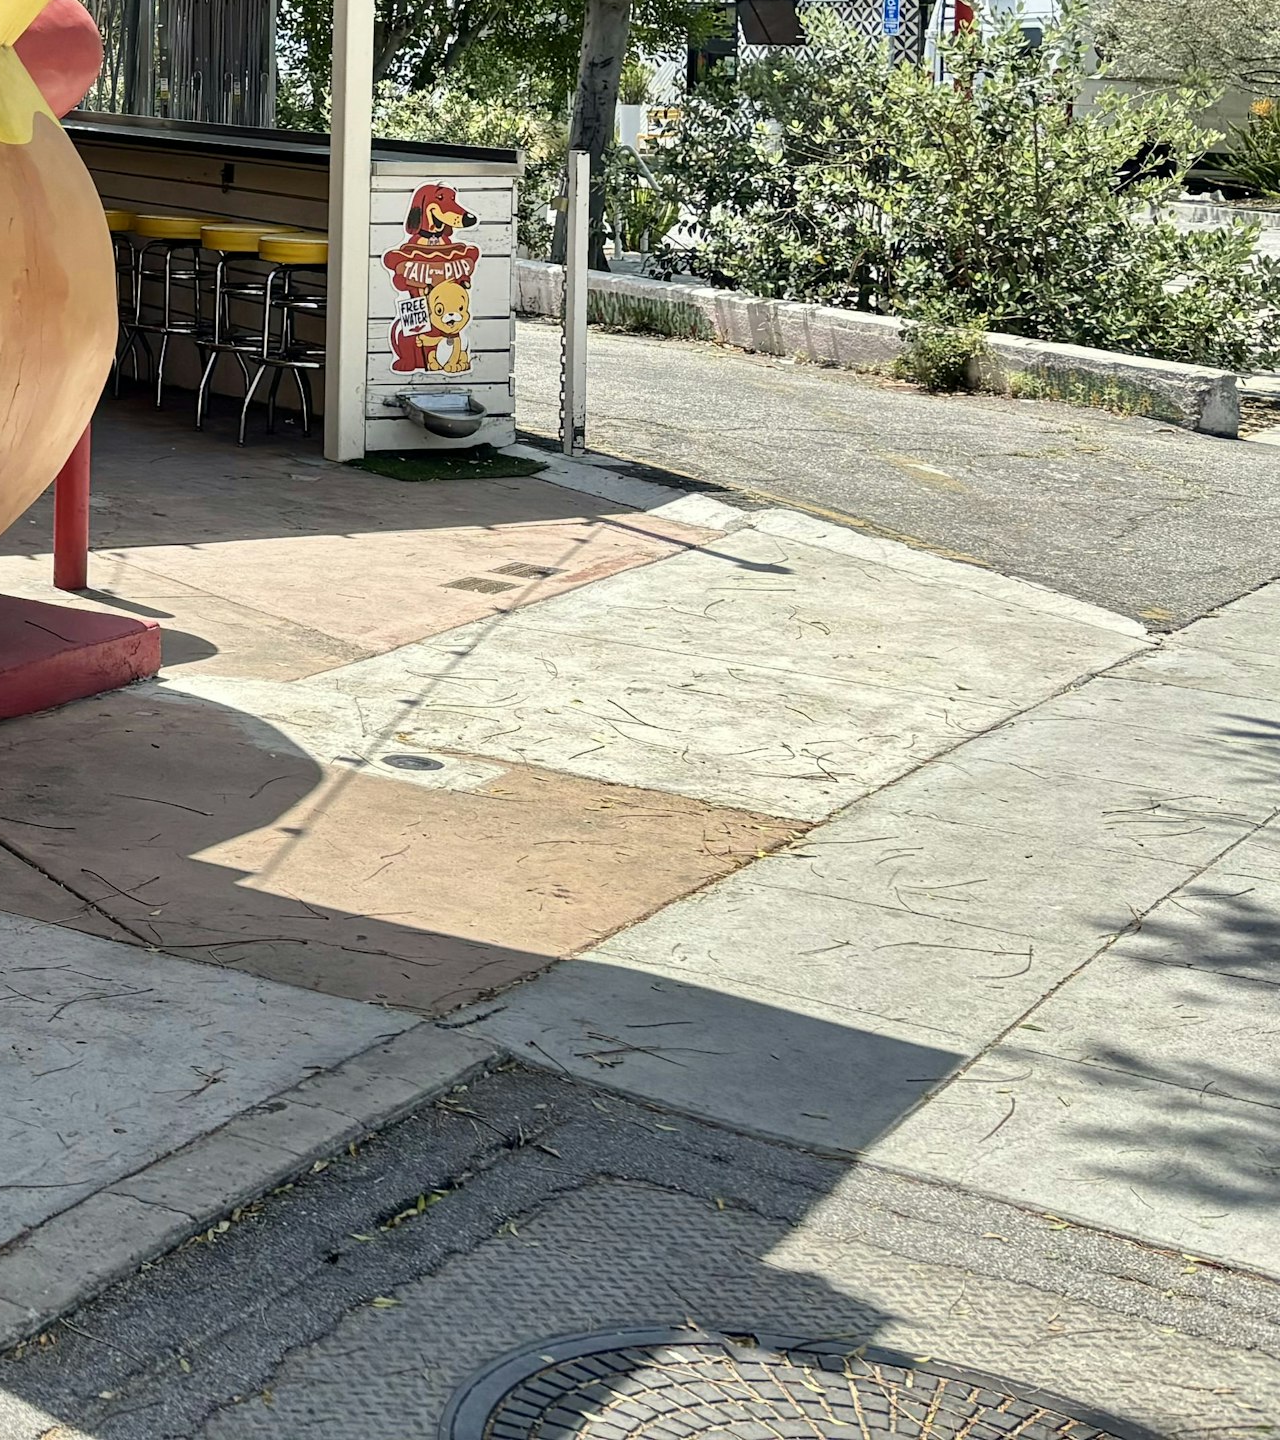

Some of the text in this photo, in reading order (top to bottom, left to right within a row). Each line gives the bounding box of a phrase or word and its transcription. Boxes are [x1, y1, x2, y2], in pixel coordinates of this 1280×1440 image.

[403, 261, 433, 284] TAIL
[444, 259, 471, 280] PUP
[400, 298, 426, 314] FREE
[402, 311, 428, 327] WATER
